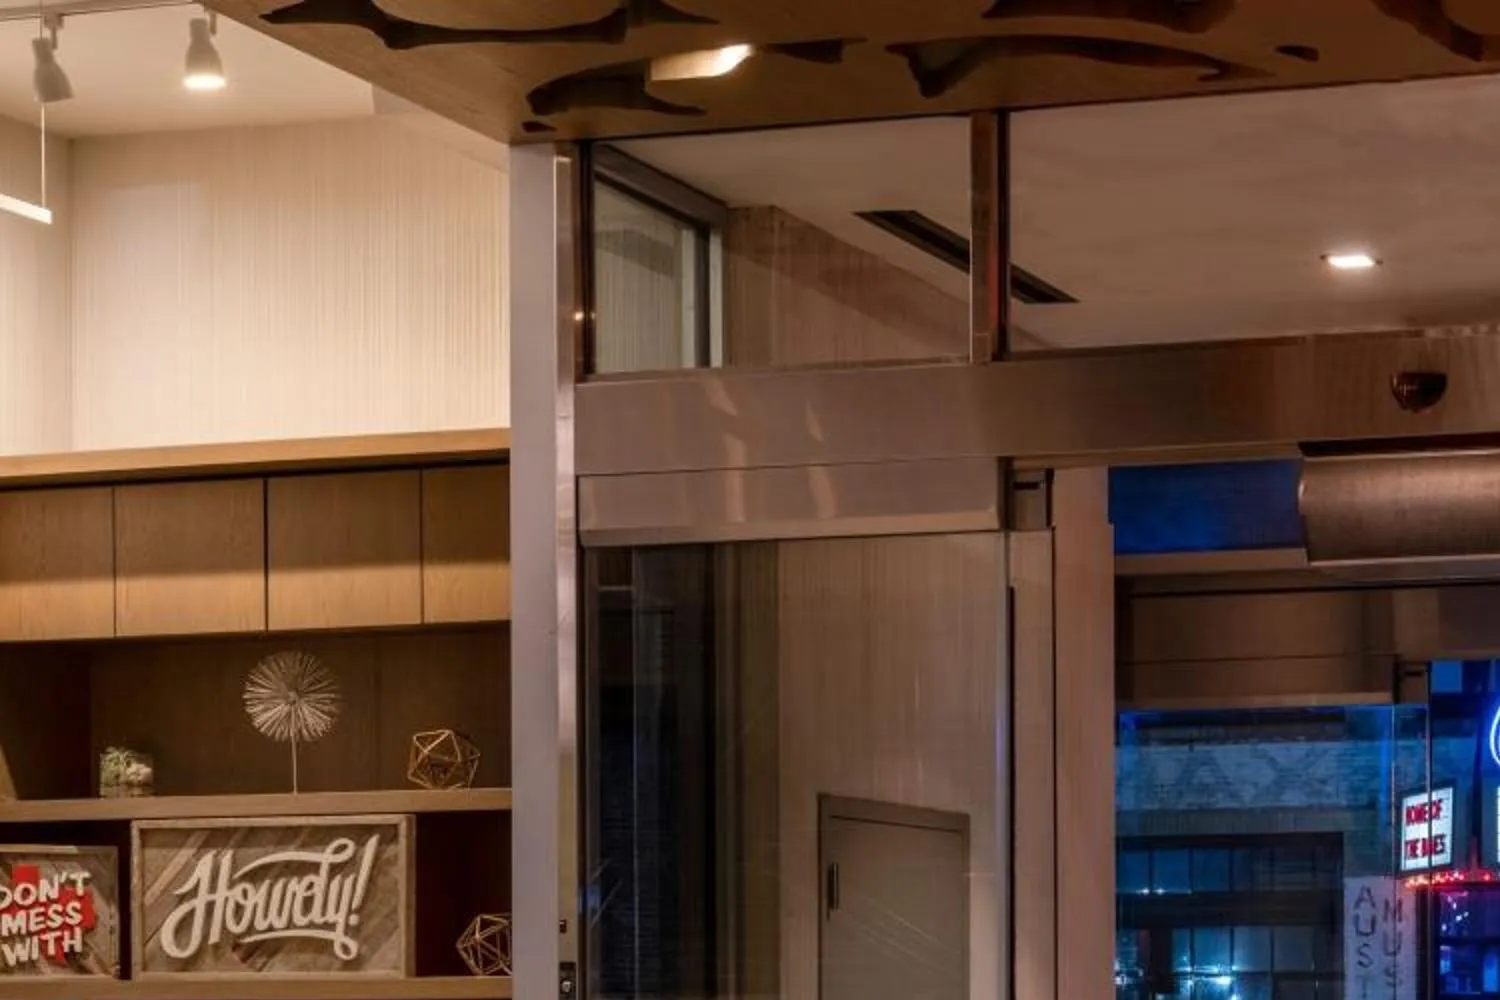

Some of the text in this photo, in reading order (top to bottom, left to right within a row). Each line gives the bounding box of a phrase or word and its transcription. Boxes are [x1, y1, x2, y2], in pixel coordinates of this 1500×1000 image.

[161, 833, 381, 960] Howdy!
[1, 901, 83, 936] MESS
[2, 926, 82, 967] WITH
